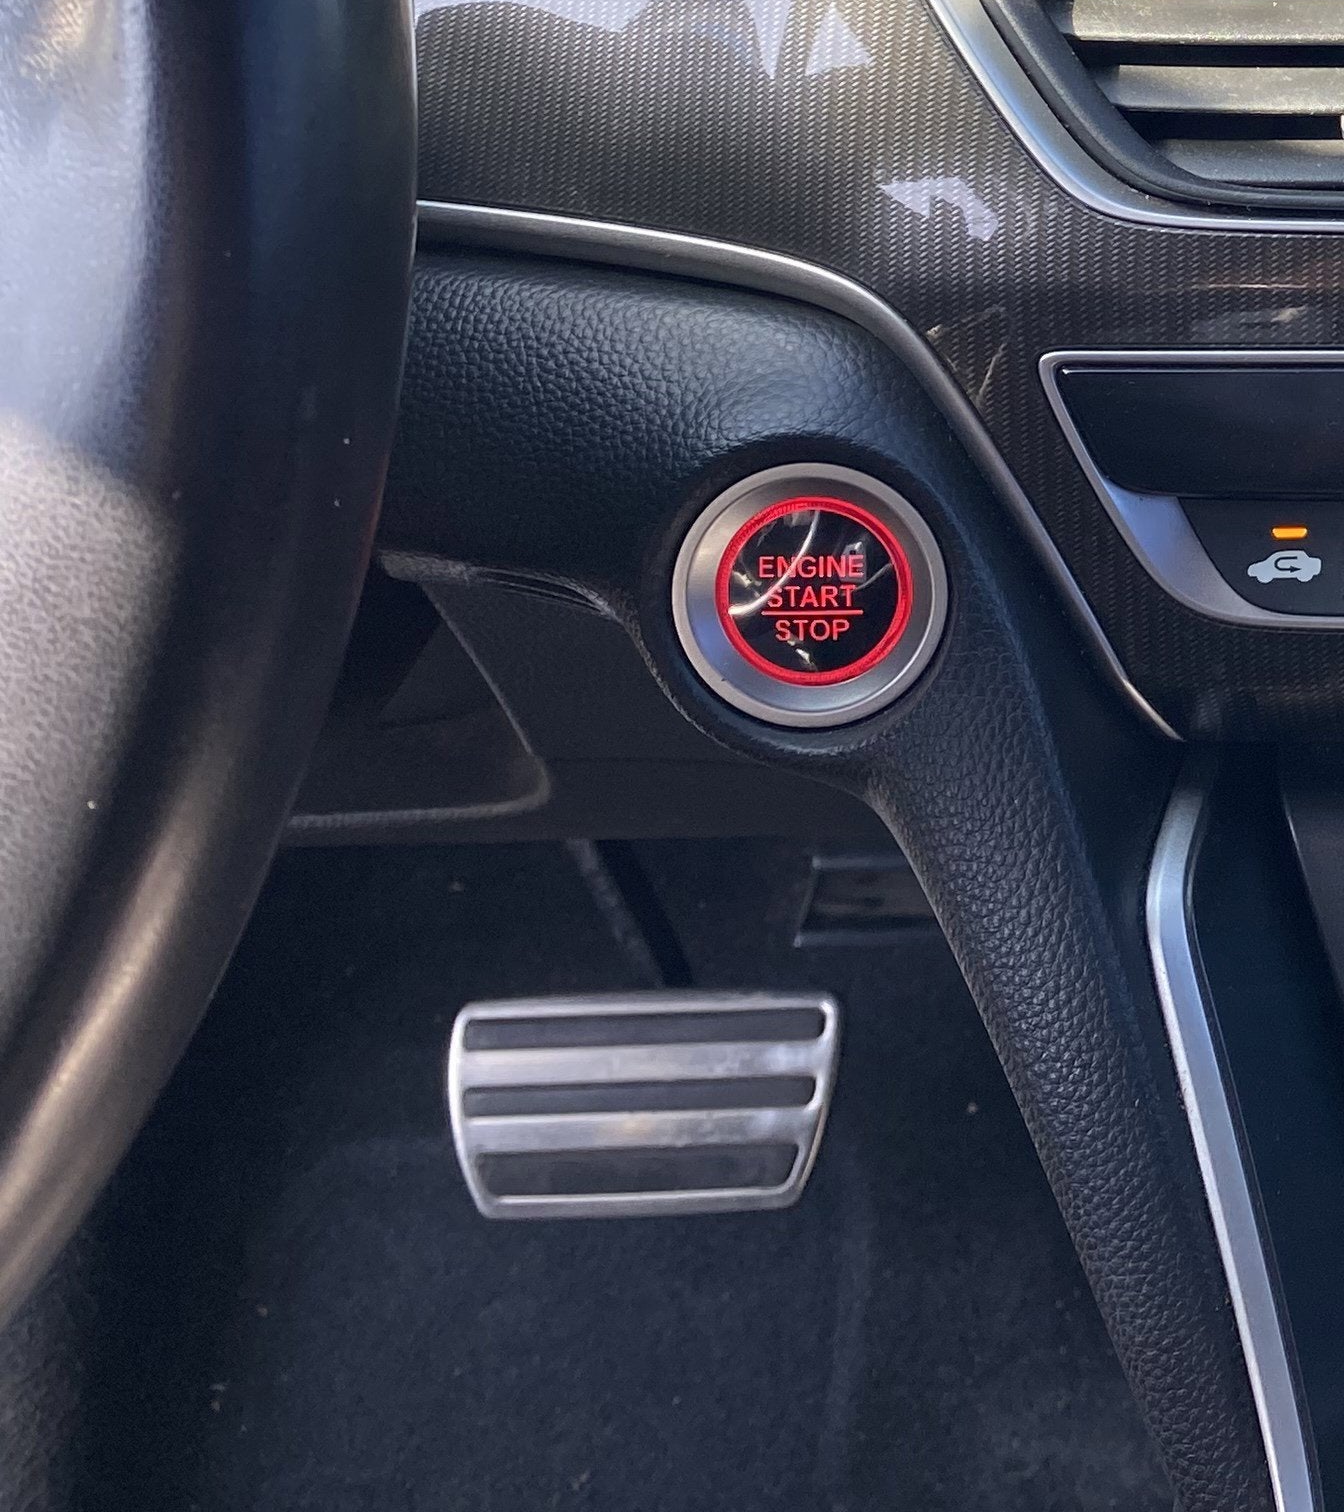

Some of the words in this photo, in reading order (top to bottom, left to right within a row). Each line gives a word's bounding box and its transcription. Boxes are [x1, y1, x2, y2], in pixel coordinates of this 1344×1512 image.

[758, 555, 865, 578] ENGINE
[767, 584, 857, 608] START
[774, 619, 850, 642] STOP
